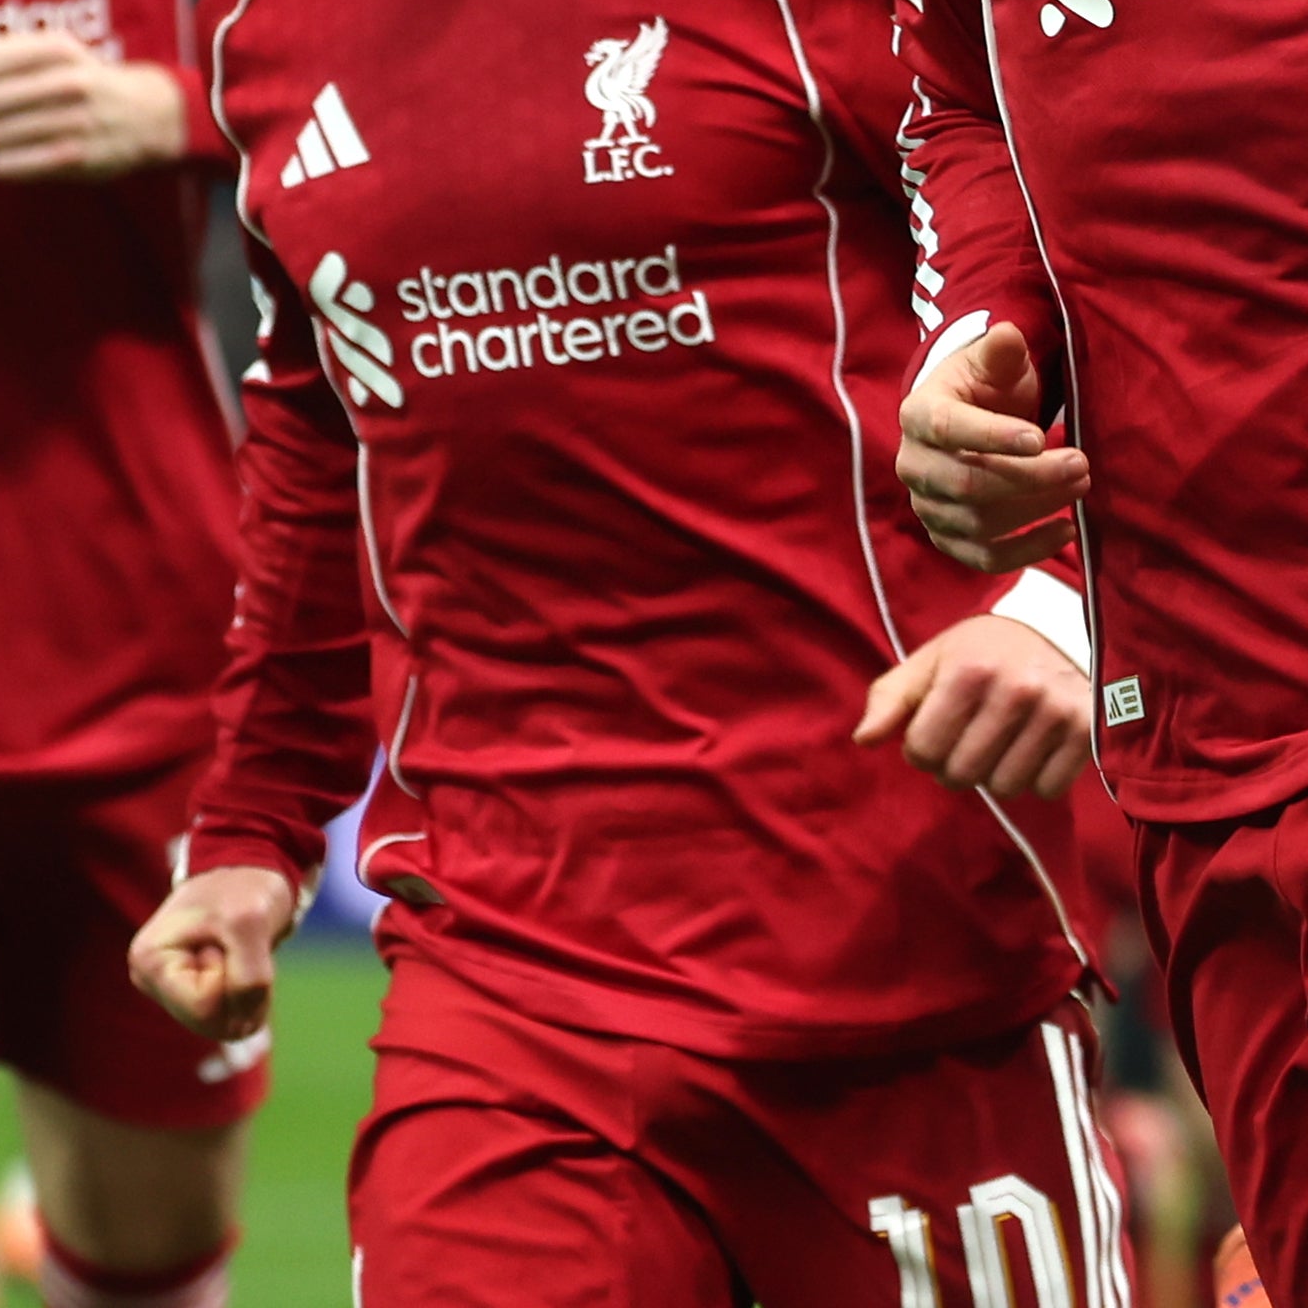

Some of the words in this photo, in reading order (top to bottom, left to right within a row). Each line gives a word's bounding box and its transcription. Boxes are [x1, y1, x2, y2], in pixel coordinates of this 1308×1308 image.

[582, 144, 675, 184] L.F.C.
[396, 243, 682, 323] standard
[410, 290, 715, 379] chartered
[867, 1174, 1076, 1308] 10
